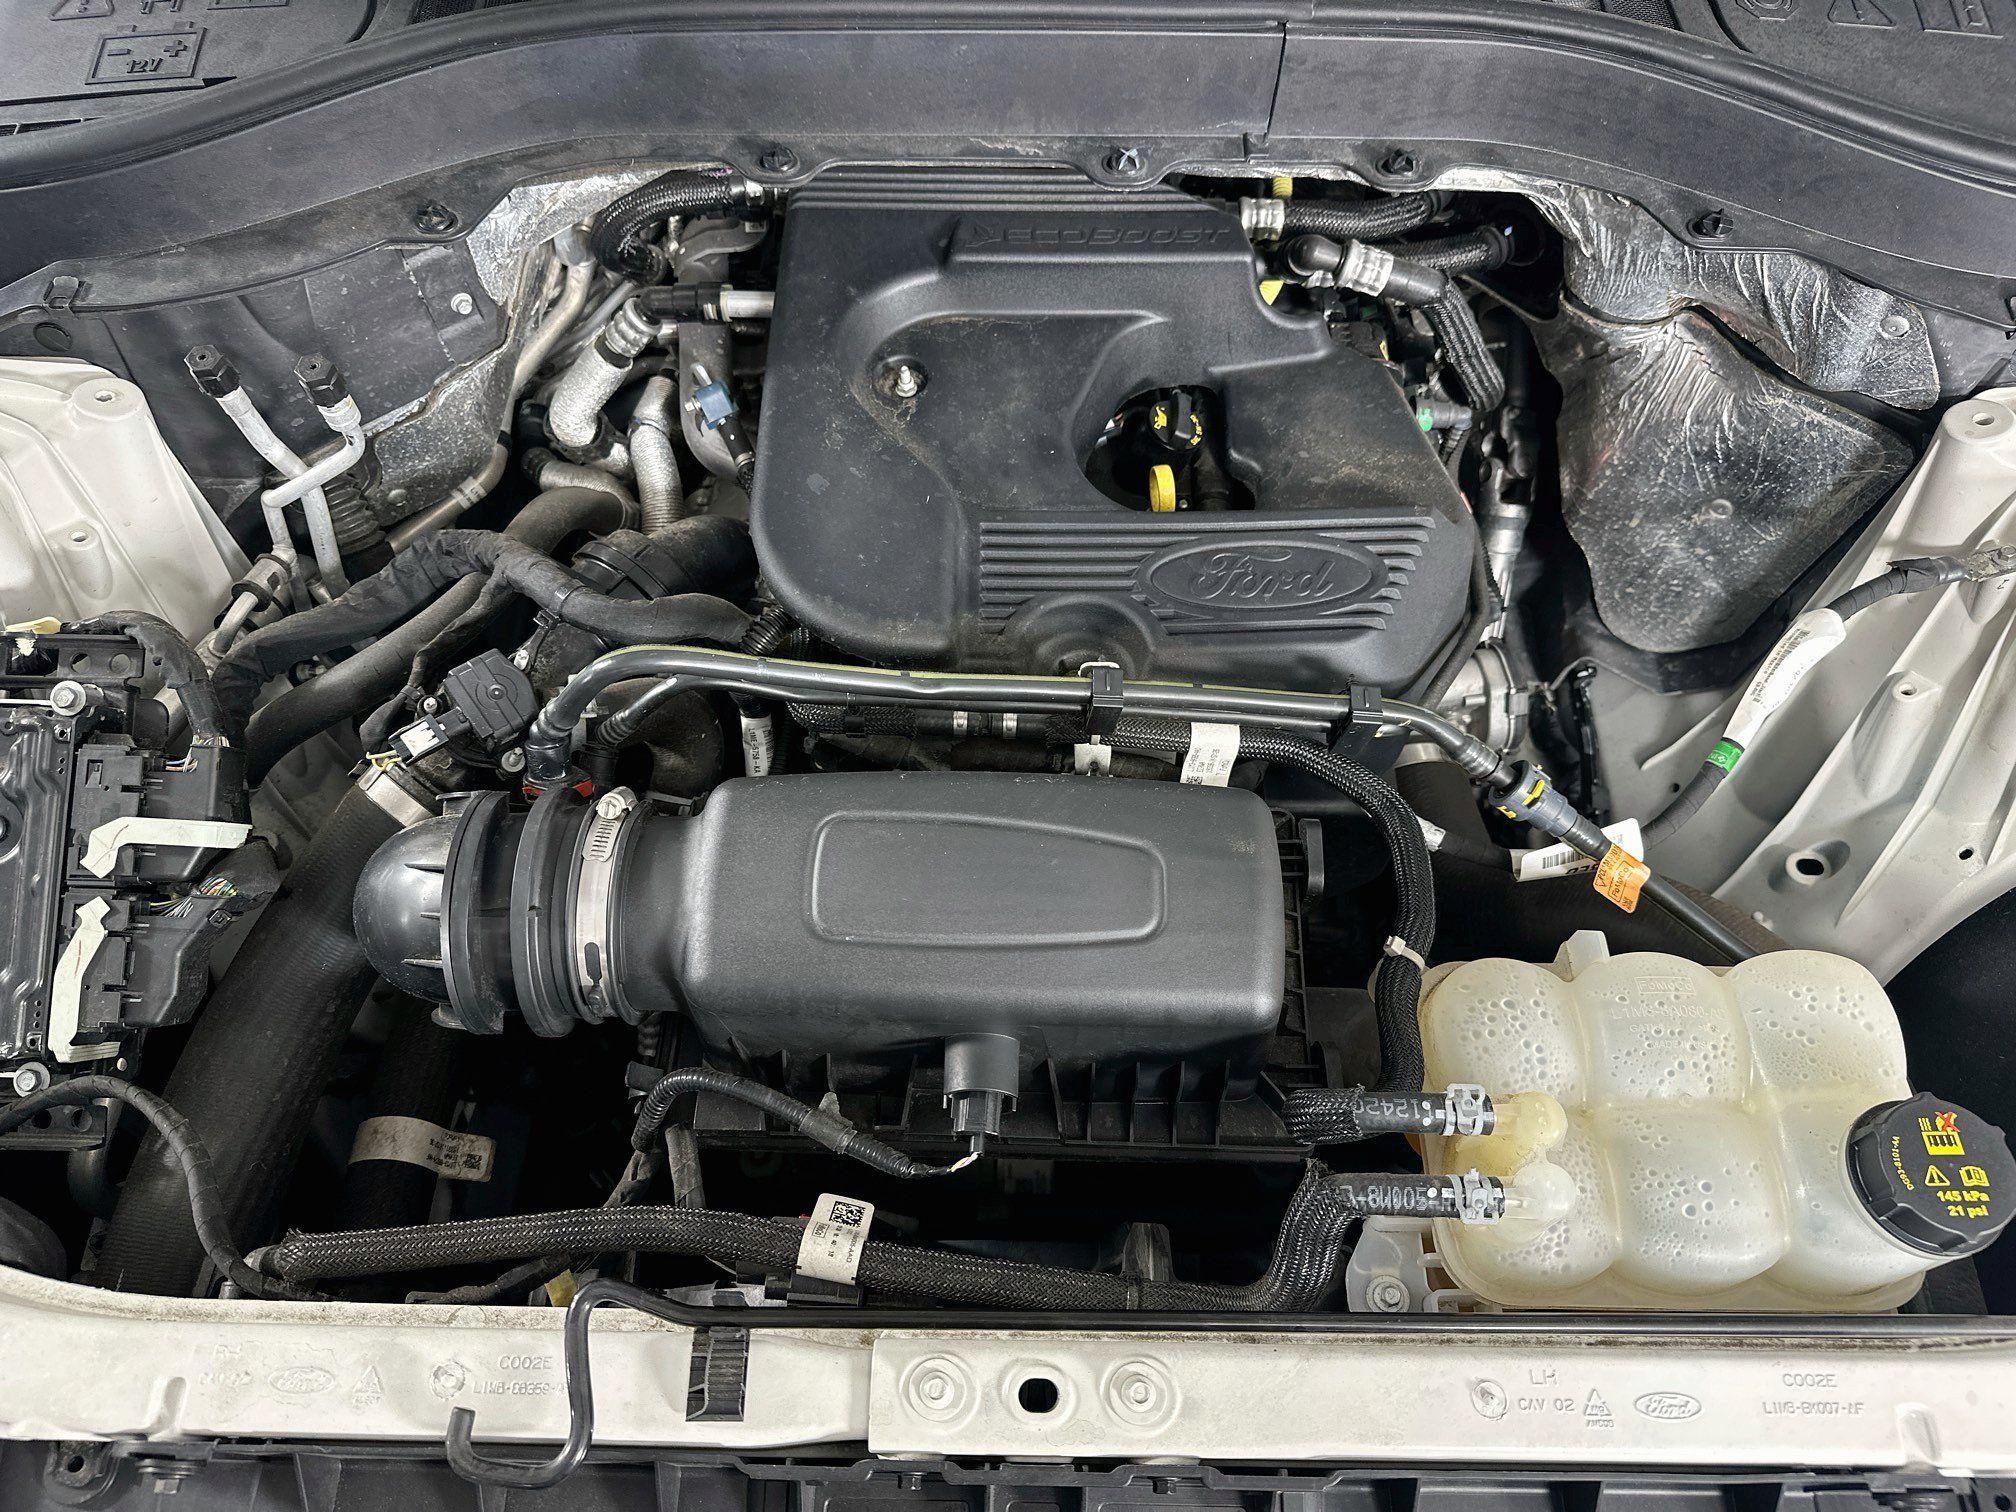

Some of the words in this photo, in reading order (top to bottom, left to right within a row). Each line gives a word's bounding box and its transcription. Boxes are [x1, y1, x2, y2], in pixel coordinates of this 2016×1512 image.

[127, 57, 163, 74] 12V
[1191, 549, 1337, 600] Ford
[1937, 1190, 1962, 1202] 145
[1962, 1190, 1990, 1202] kPa
[1947, 1205, 1965, 1217] 21
[1966, 1204, 1989, 1219] psi
[1530, 1368, 1557, 1386] LH
[1554, 1397, 1576, 1412] 02
[1647, 1394, 1693, 1418] Ford
